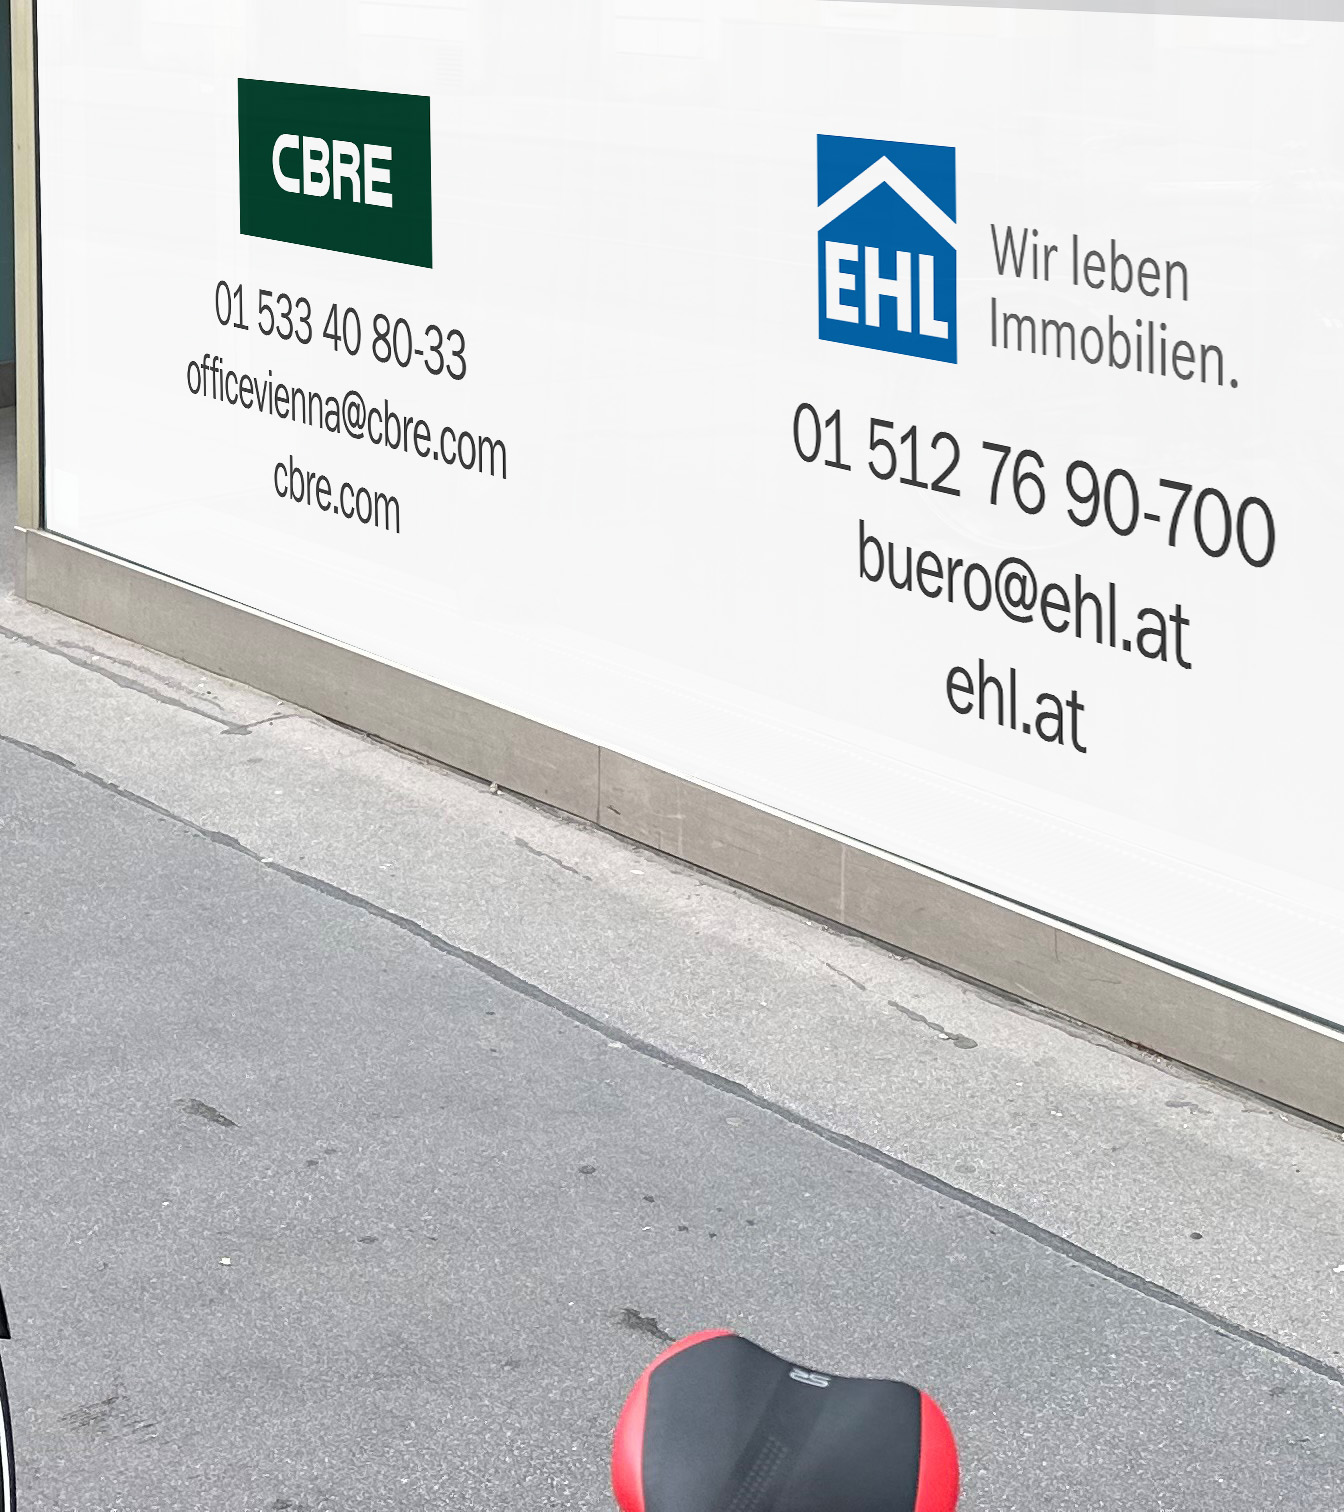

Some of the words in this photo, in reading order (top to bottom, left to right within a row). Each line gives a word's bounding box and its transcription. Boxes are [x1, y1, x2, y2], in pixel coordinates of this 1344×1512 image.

[272, 133, 393, 208] CBRE
[825, 240, 949, 340] EHL
[990, 223, 1058, 282] Wir
[1072, 234, 1189, 302] leben
[215, 280, 249, 331] 01
[257, 288, 313, 345] 533
[322, 303, 362, 357] 40
[371, 313, 467, 381] 80-33
[990, 297, 1239, 389] Immobilien.
[186, 353, 507, 480] officevienna@cbre.com
[273, 454, 400, 534] cbre.com
[793, 402, 852, 472] 01
[868, 417, 961, 497] 512
[982, 440, 1046, 516] 76
[1065, 459, 1276, 568] 90-700
[858, 518, 1192, 670] buero@ehl.at
[946, 657, 1087, 754] ehl.at
